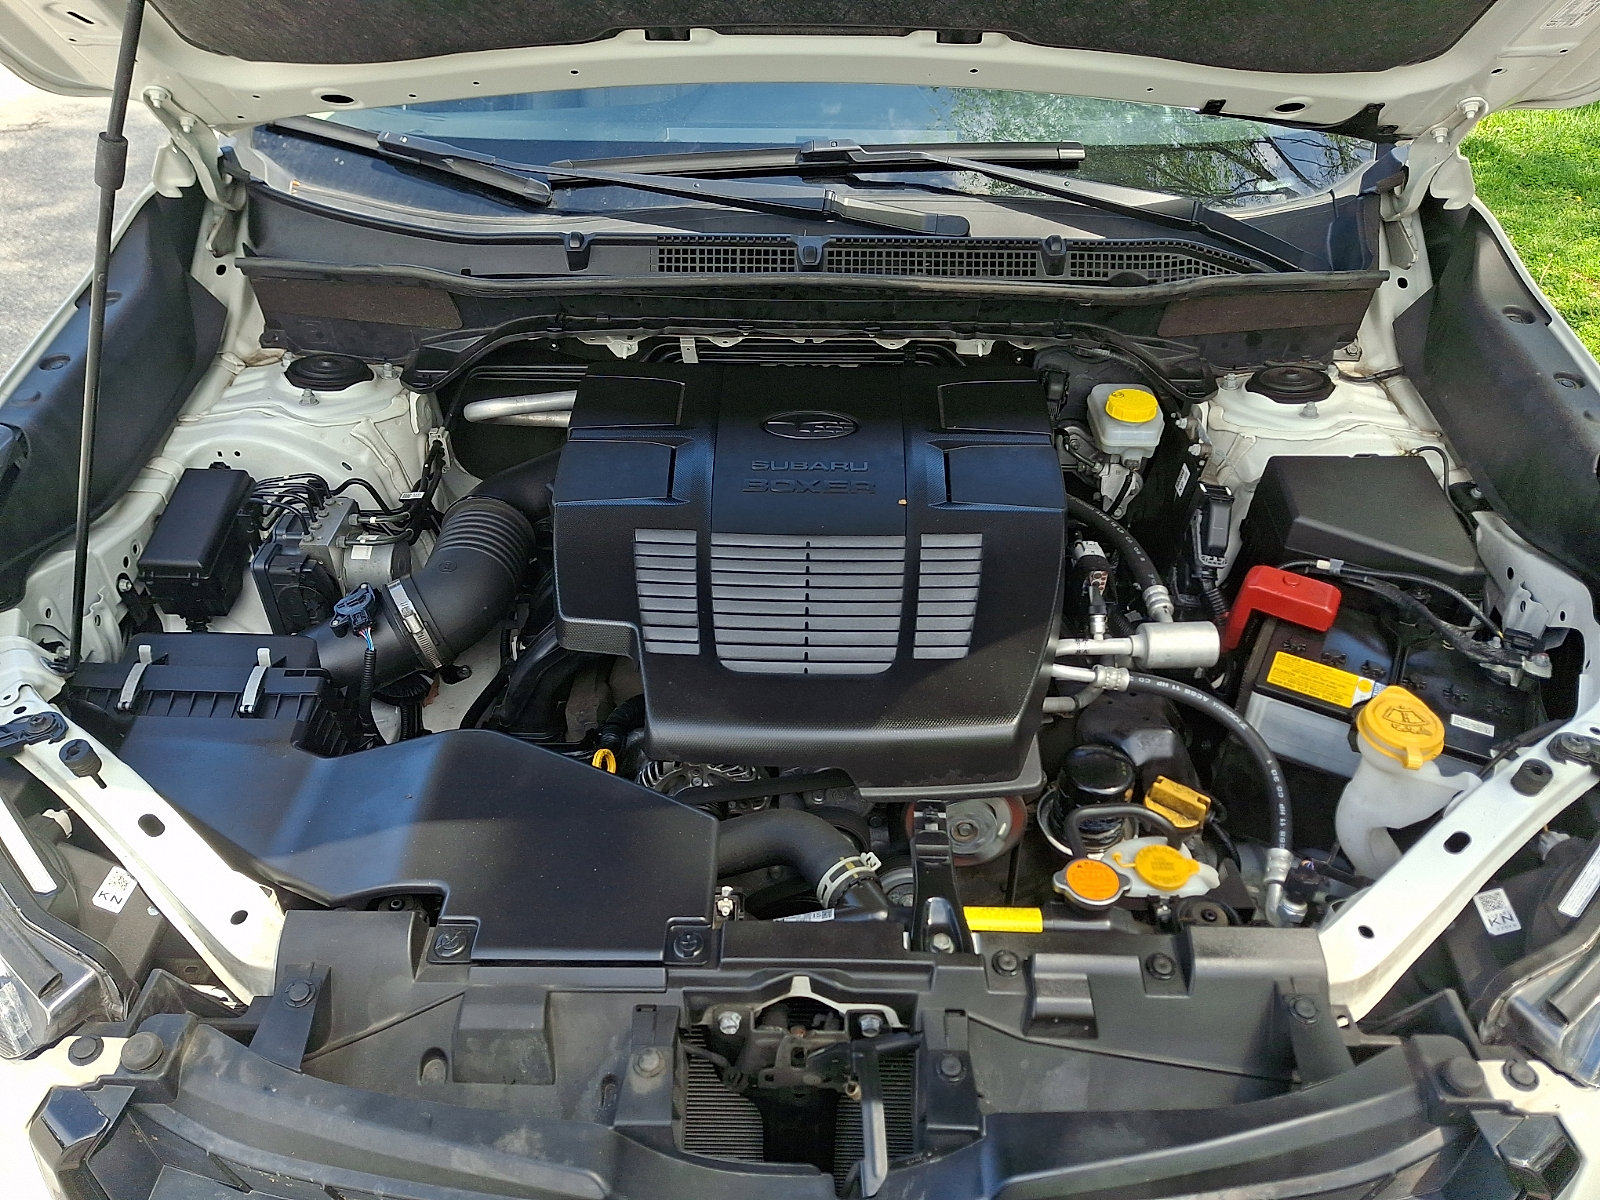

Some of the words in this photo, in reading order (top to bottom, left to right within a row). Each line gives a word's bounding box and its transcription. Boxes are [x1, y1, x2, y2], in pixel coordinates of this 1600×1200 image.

[751, 460, 869, 473] SUBARU
[742, 478, 876, 494] BOXER
[99, 891, 123, 904] KN
[1487, 912, 1515, 927] KN
